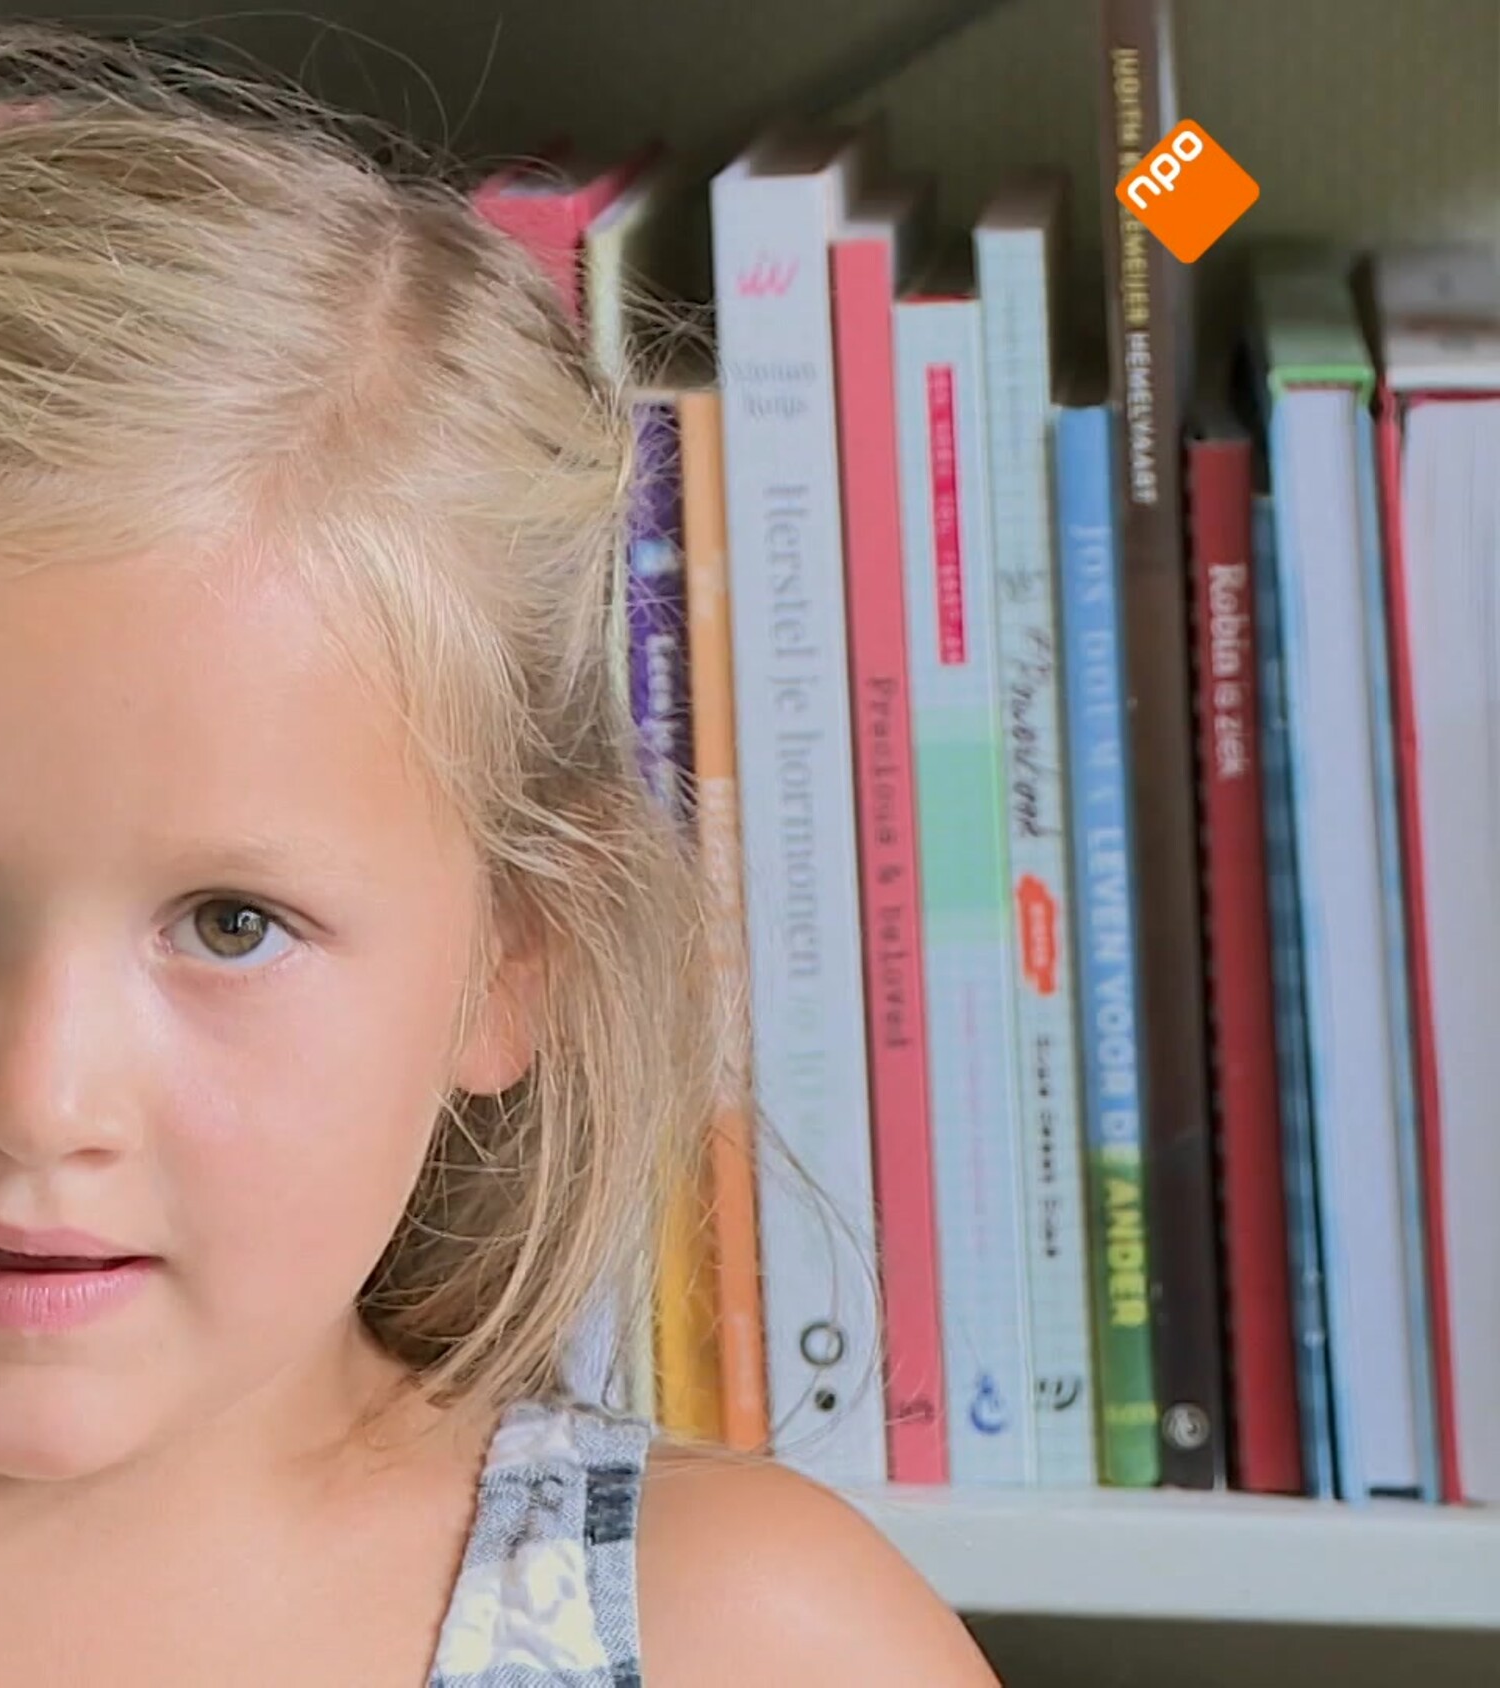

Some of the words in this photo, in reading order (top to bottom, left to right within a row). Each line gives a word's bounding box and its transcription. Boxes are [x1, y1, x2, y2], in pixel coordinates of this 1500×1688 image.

[1112, 49, 1144, 146] JUDITH
[1117, 152, 1150, 326] KEMEIJER
[1125, 332, 1158, 503] HEMELVAART
[763, 484, 823, 662] Herstel
[1208, 563, 1250, 677] Robin
[766, 674, 821, 713] je
[1213, 680, 1250, 709] is
[866, 677, 901, 846] Precious
[775, 729, 826, 980] hormonen
[877, 863, 907, 885] &
[1088, 828, 1130, 962] LEVEN
[882, 905, 915, 1049] beloved
[1094, 973, 1135, 1095] VOOR
[1100, 1109, 1142, 1166] DE
[1105, 1178, 1149, 1328] ANDER
